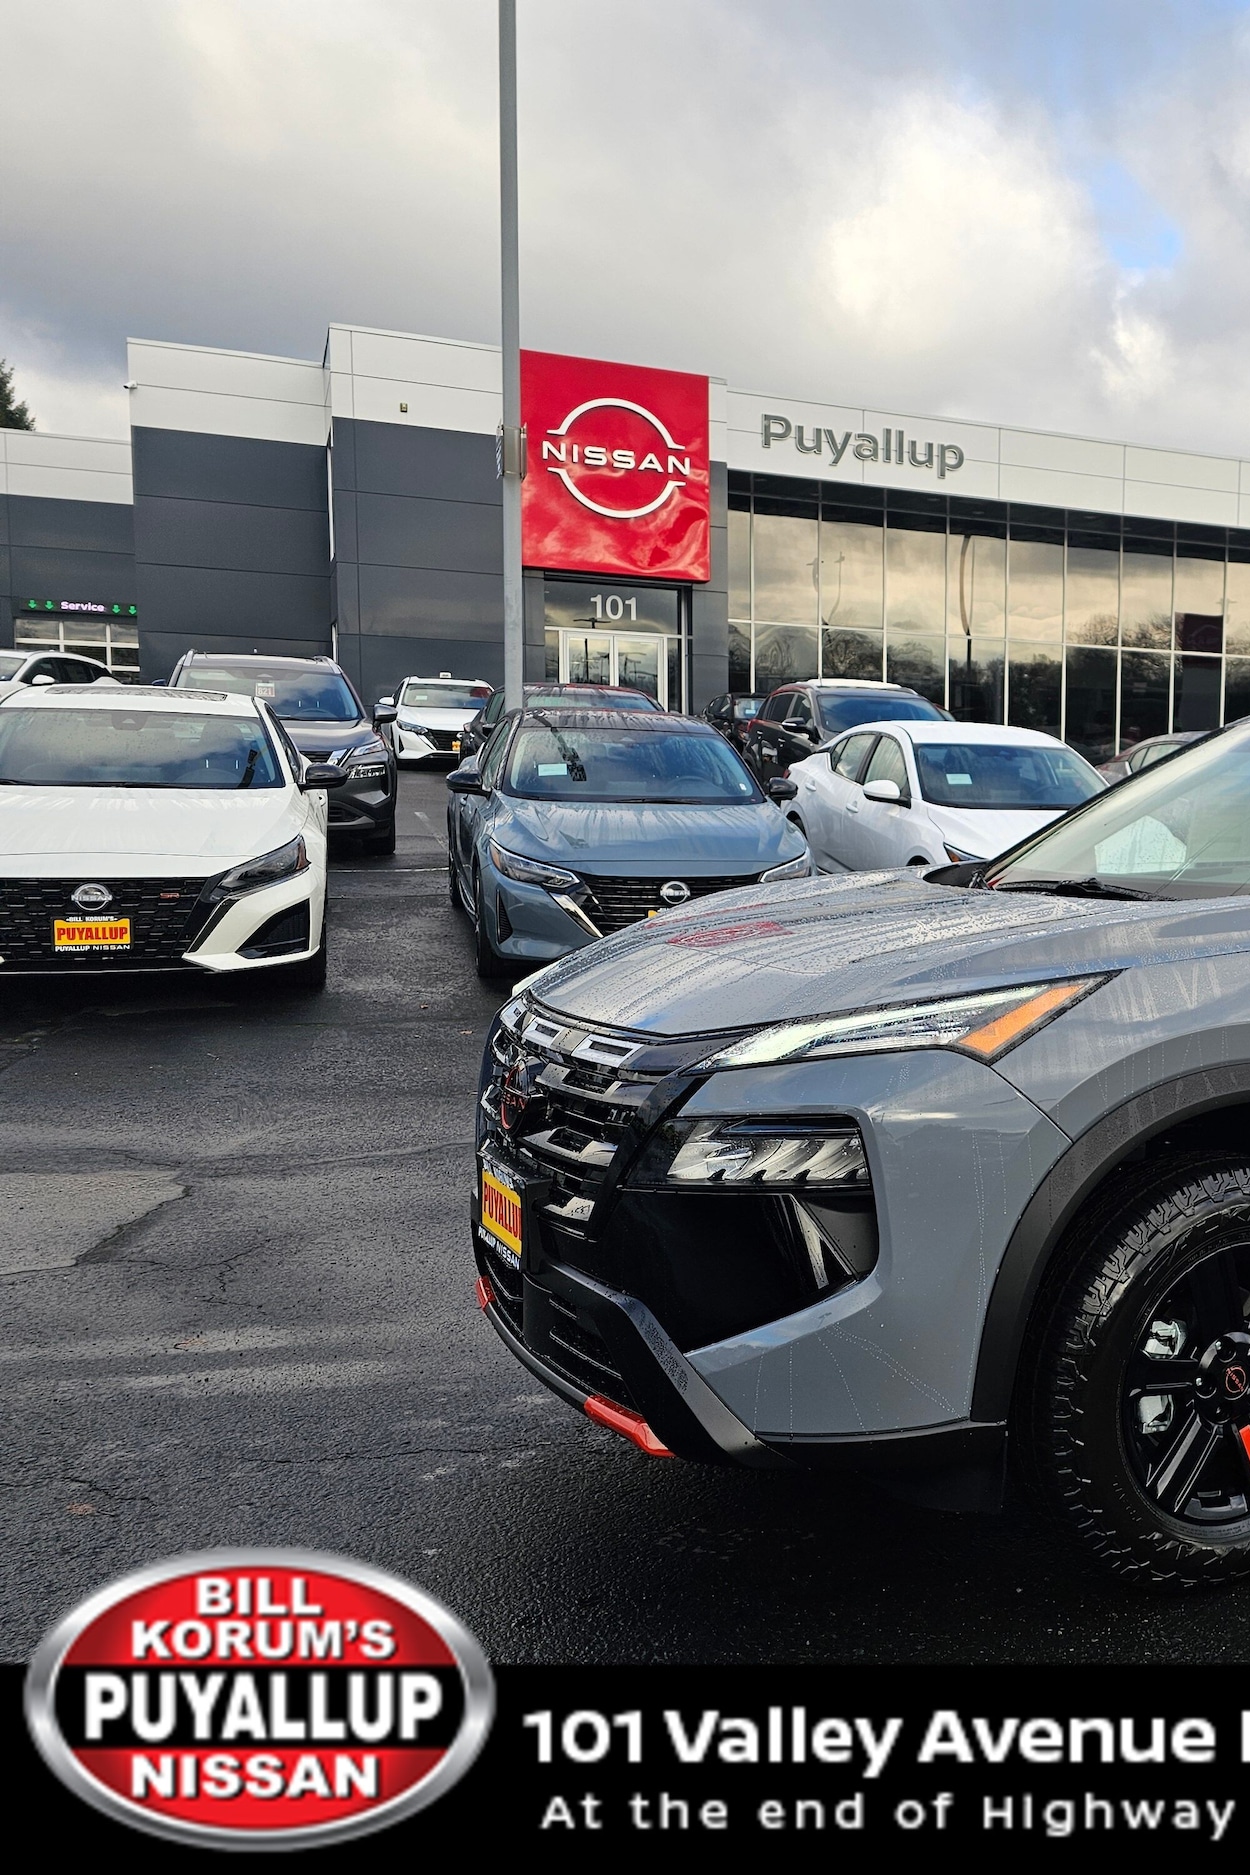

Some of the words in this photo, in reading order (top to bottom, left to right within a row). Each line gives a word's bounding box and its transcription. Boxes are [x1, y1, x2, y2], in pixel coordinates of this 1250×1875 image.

[541, 440, 691, 476] NISSAN
[761, 413, 965, 479] Puyallup
[60, 601, 105, 612] Service
[590, 594, 638, 621] 101
[56, 927, 128, 940] PUYALLUP
[496, 1240, 521, 1271] NISSAN
